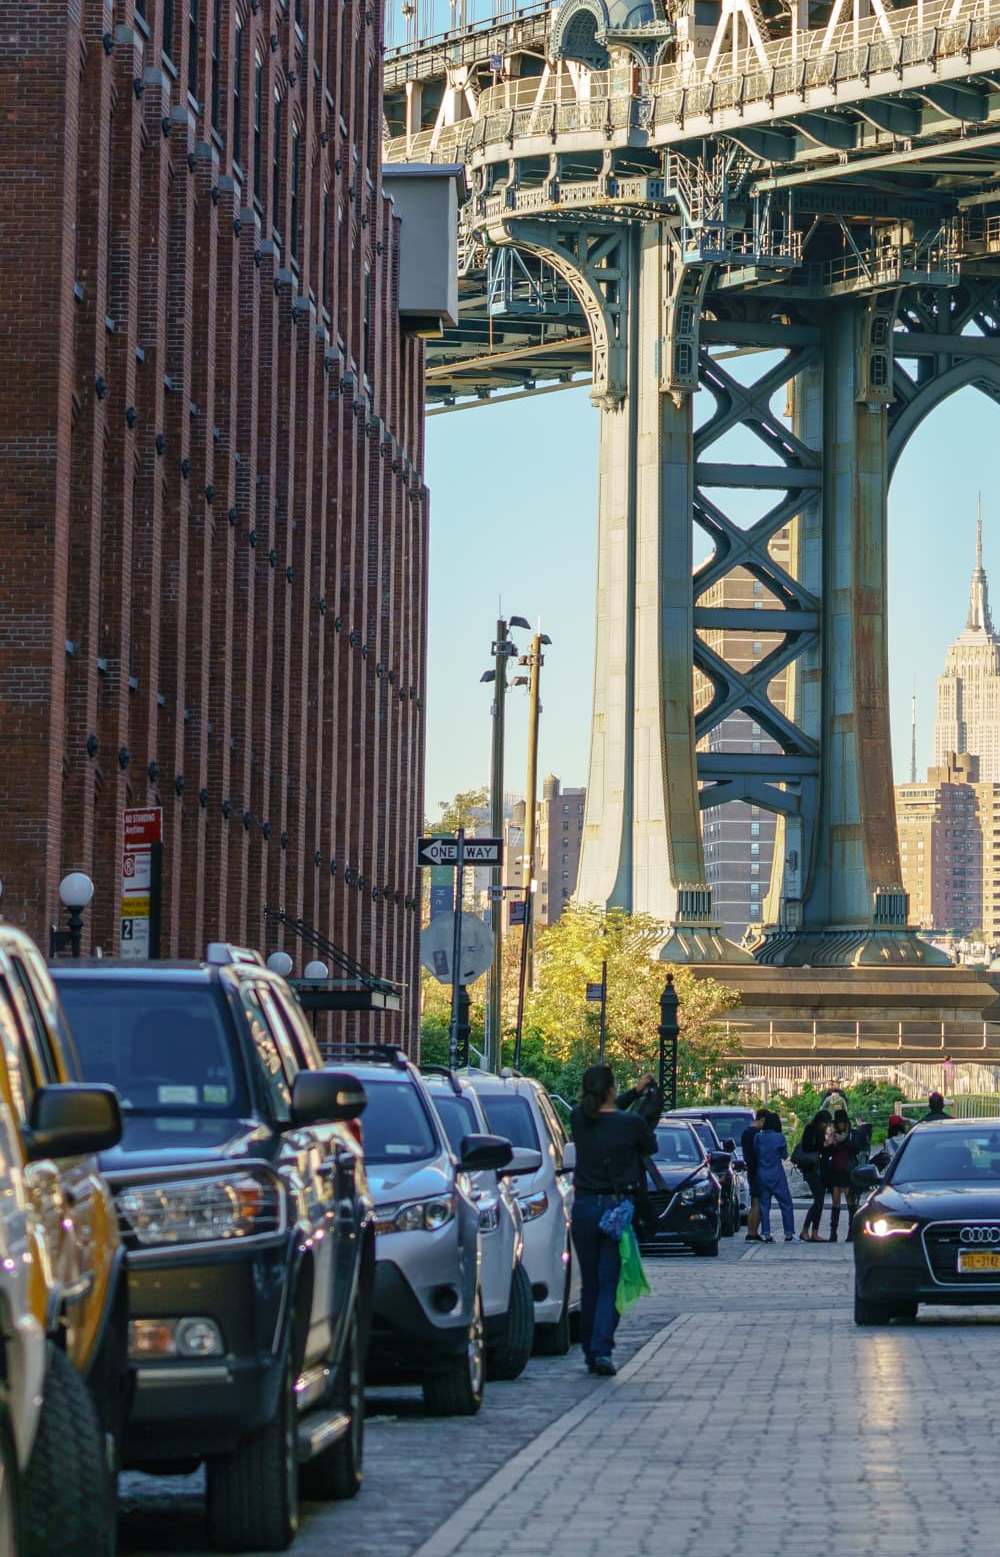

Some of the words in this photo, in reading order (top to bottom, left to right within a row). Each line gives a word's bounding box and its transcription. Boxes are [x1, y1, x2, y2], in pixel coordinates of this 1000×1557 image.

[430, 847, 455, 858] ONE
[466, 847, 492, 858] WAY
[124, 920, 131, 939] 2
